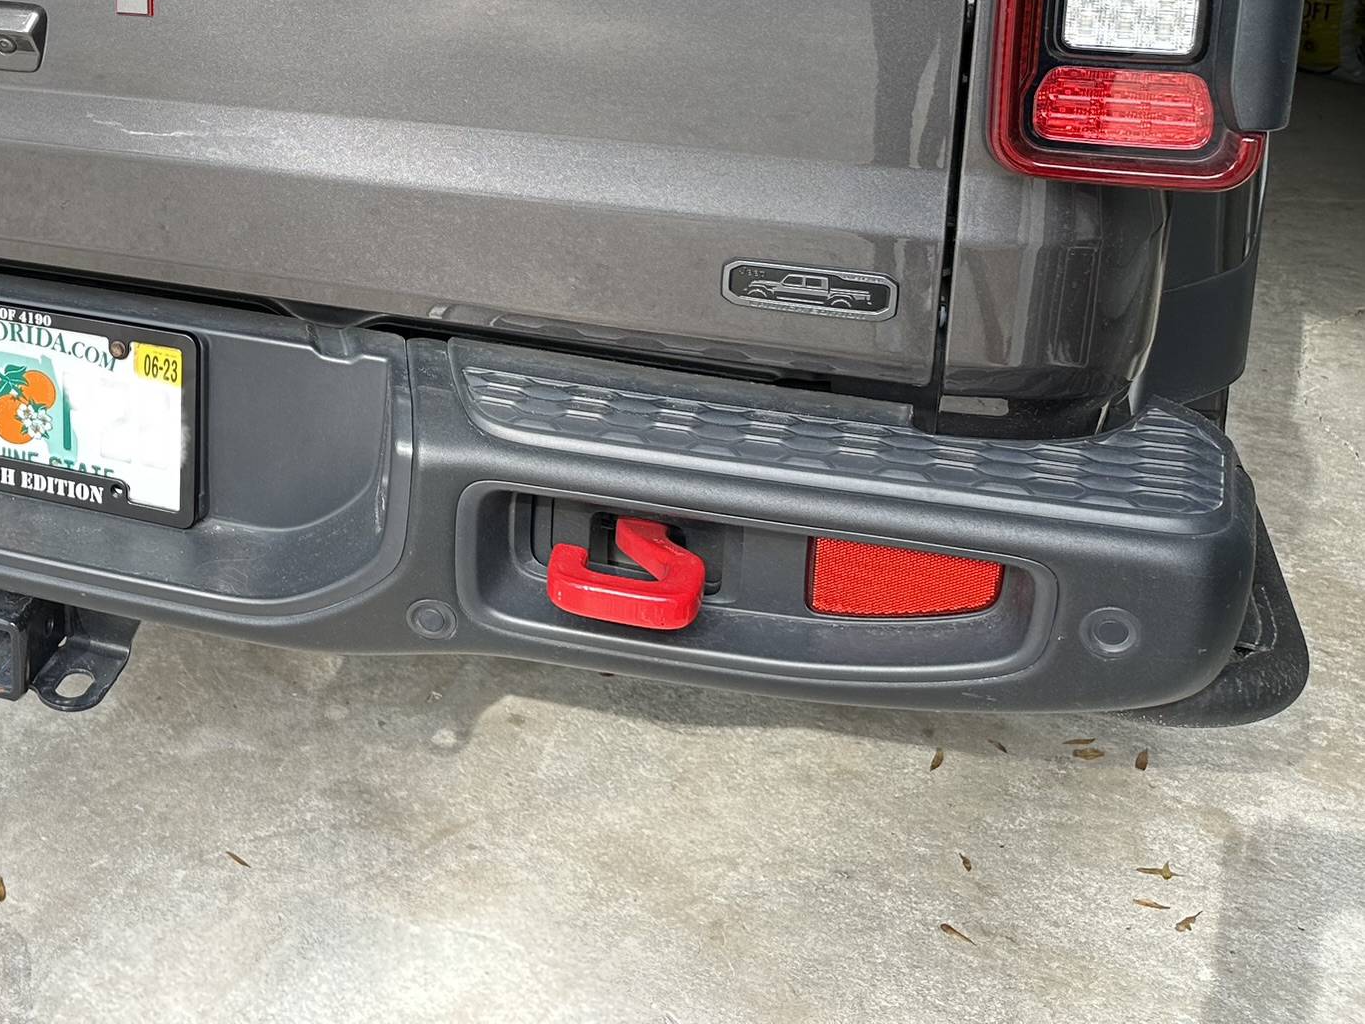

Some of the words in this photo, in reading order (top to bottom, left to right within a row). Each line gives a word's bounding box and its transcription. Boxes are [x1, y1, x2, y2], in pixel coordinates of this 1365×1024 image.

[0, 307, 18, 321] OF
[18, 311, 52, 327] 4190
[143, 353, 178, 383] 06-23
[20, 471, 105, 504] EDITION
